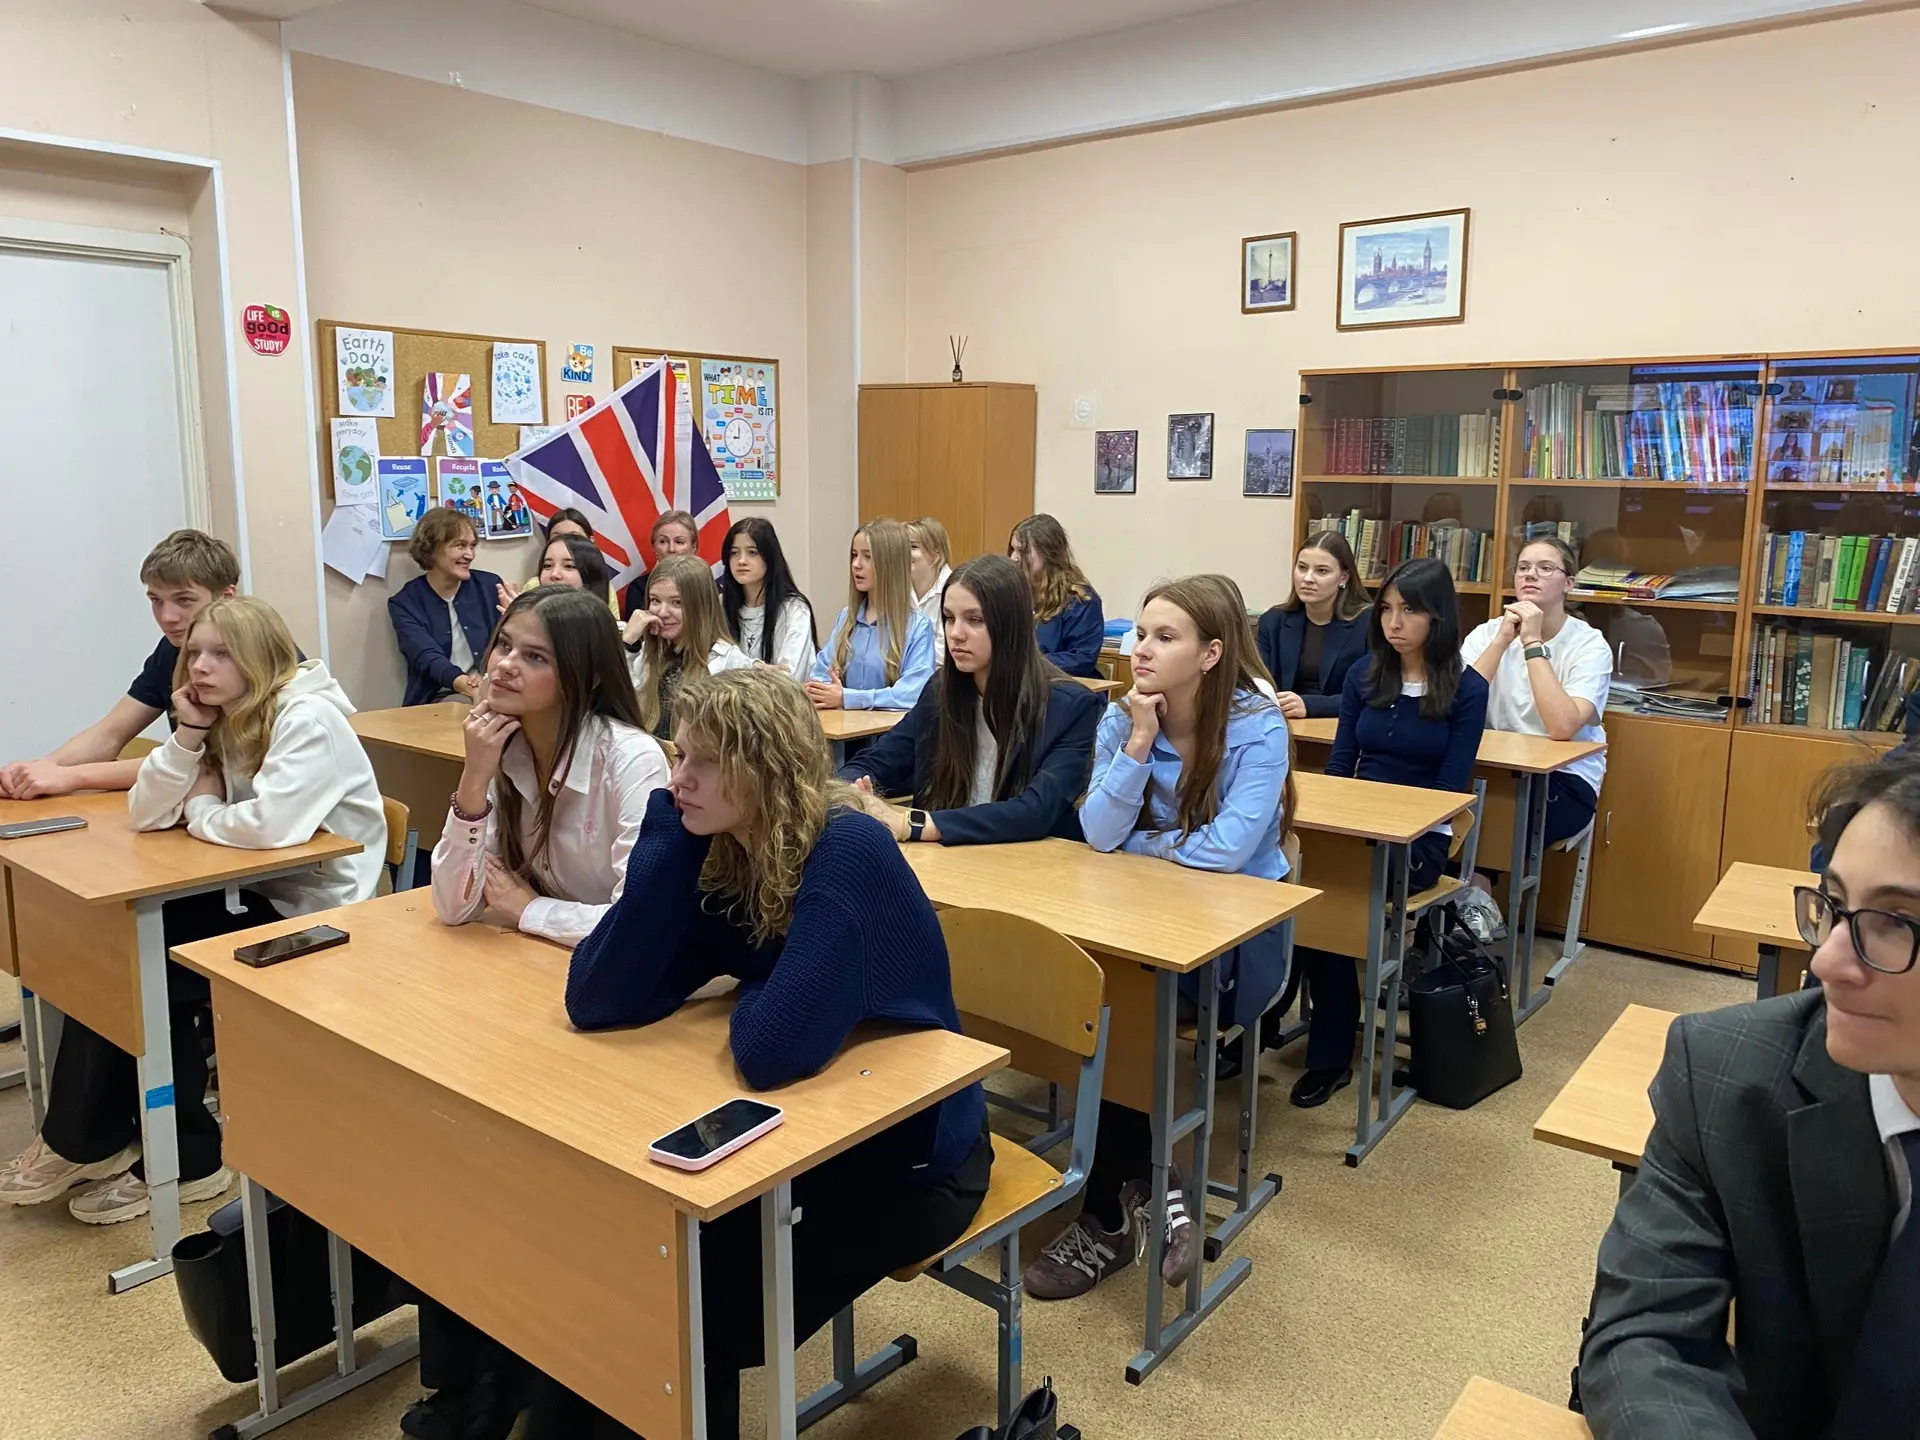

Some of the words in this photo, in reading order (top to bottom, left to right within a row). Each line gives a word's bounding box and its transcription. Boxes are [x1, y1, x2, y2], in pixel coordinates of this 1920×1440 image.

[247, 310, 264, 322] LIFE
[271, 310, 280, 318] IS
[247, 322, 289, 335] goOd
[254, 338, 283, 352] STUDY!
[342, 337, 385, 354] Earth
[579, 346, 593, 357] Be
[348, 352, 380, 367] Day
[512, 351, 534, 365] care
[563, 368, 592, 382] KIND!
[703, 373, 721, 382] WHAT
[708, 383, 768, 407] TIME
[567, 396, 583, 420] BE
[758, 407, 764, 416] IS
[765, 407, 774, 417] IT?
[391, 463, 412, 471] Reuse
[451, 463, 477, 472] Recycle
